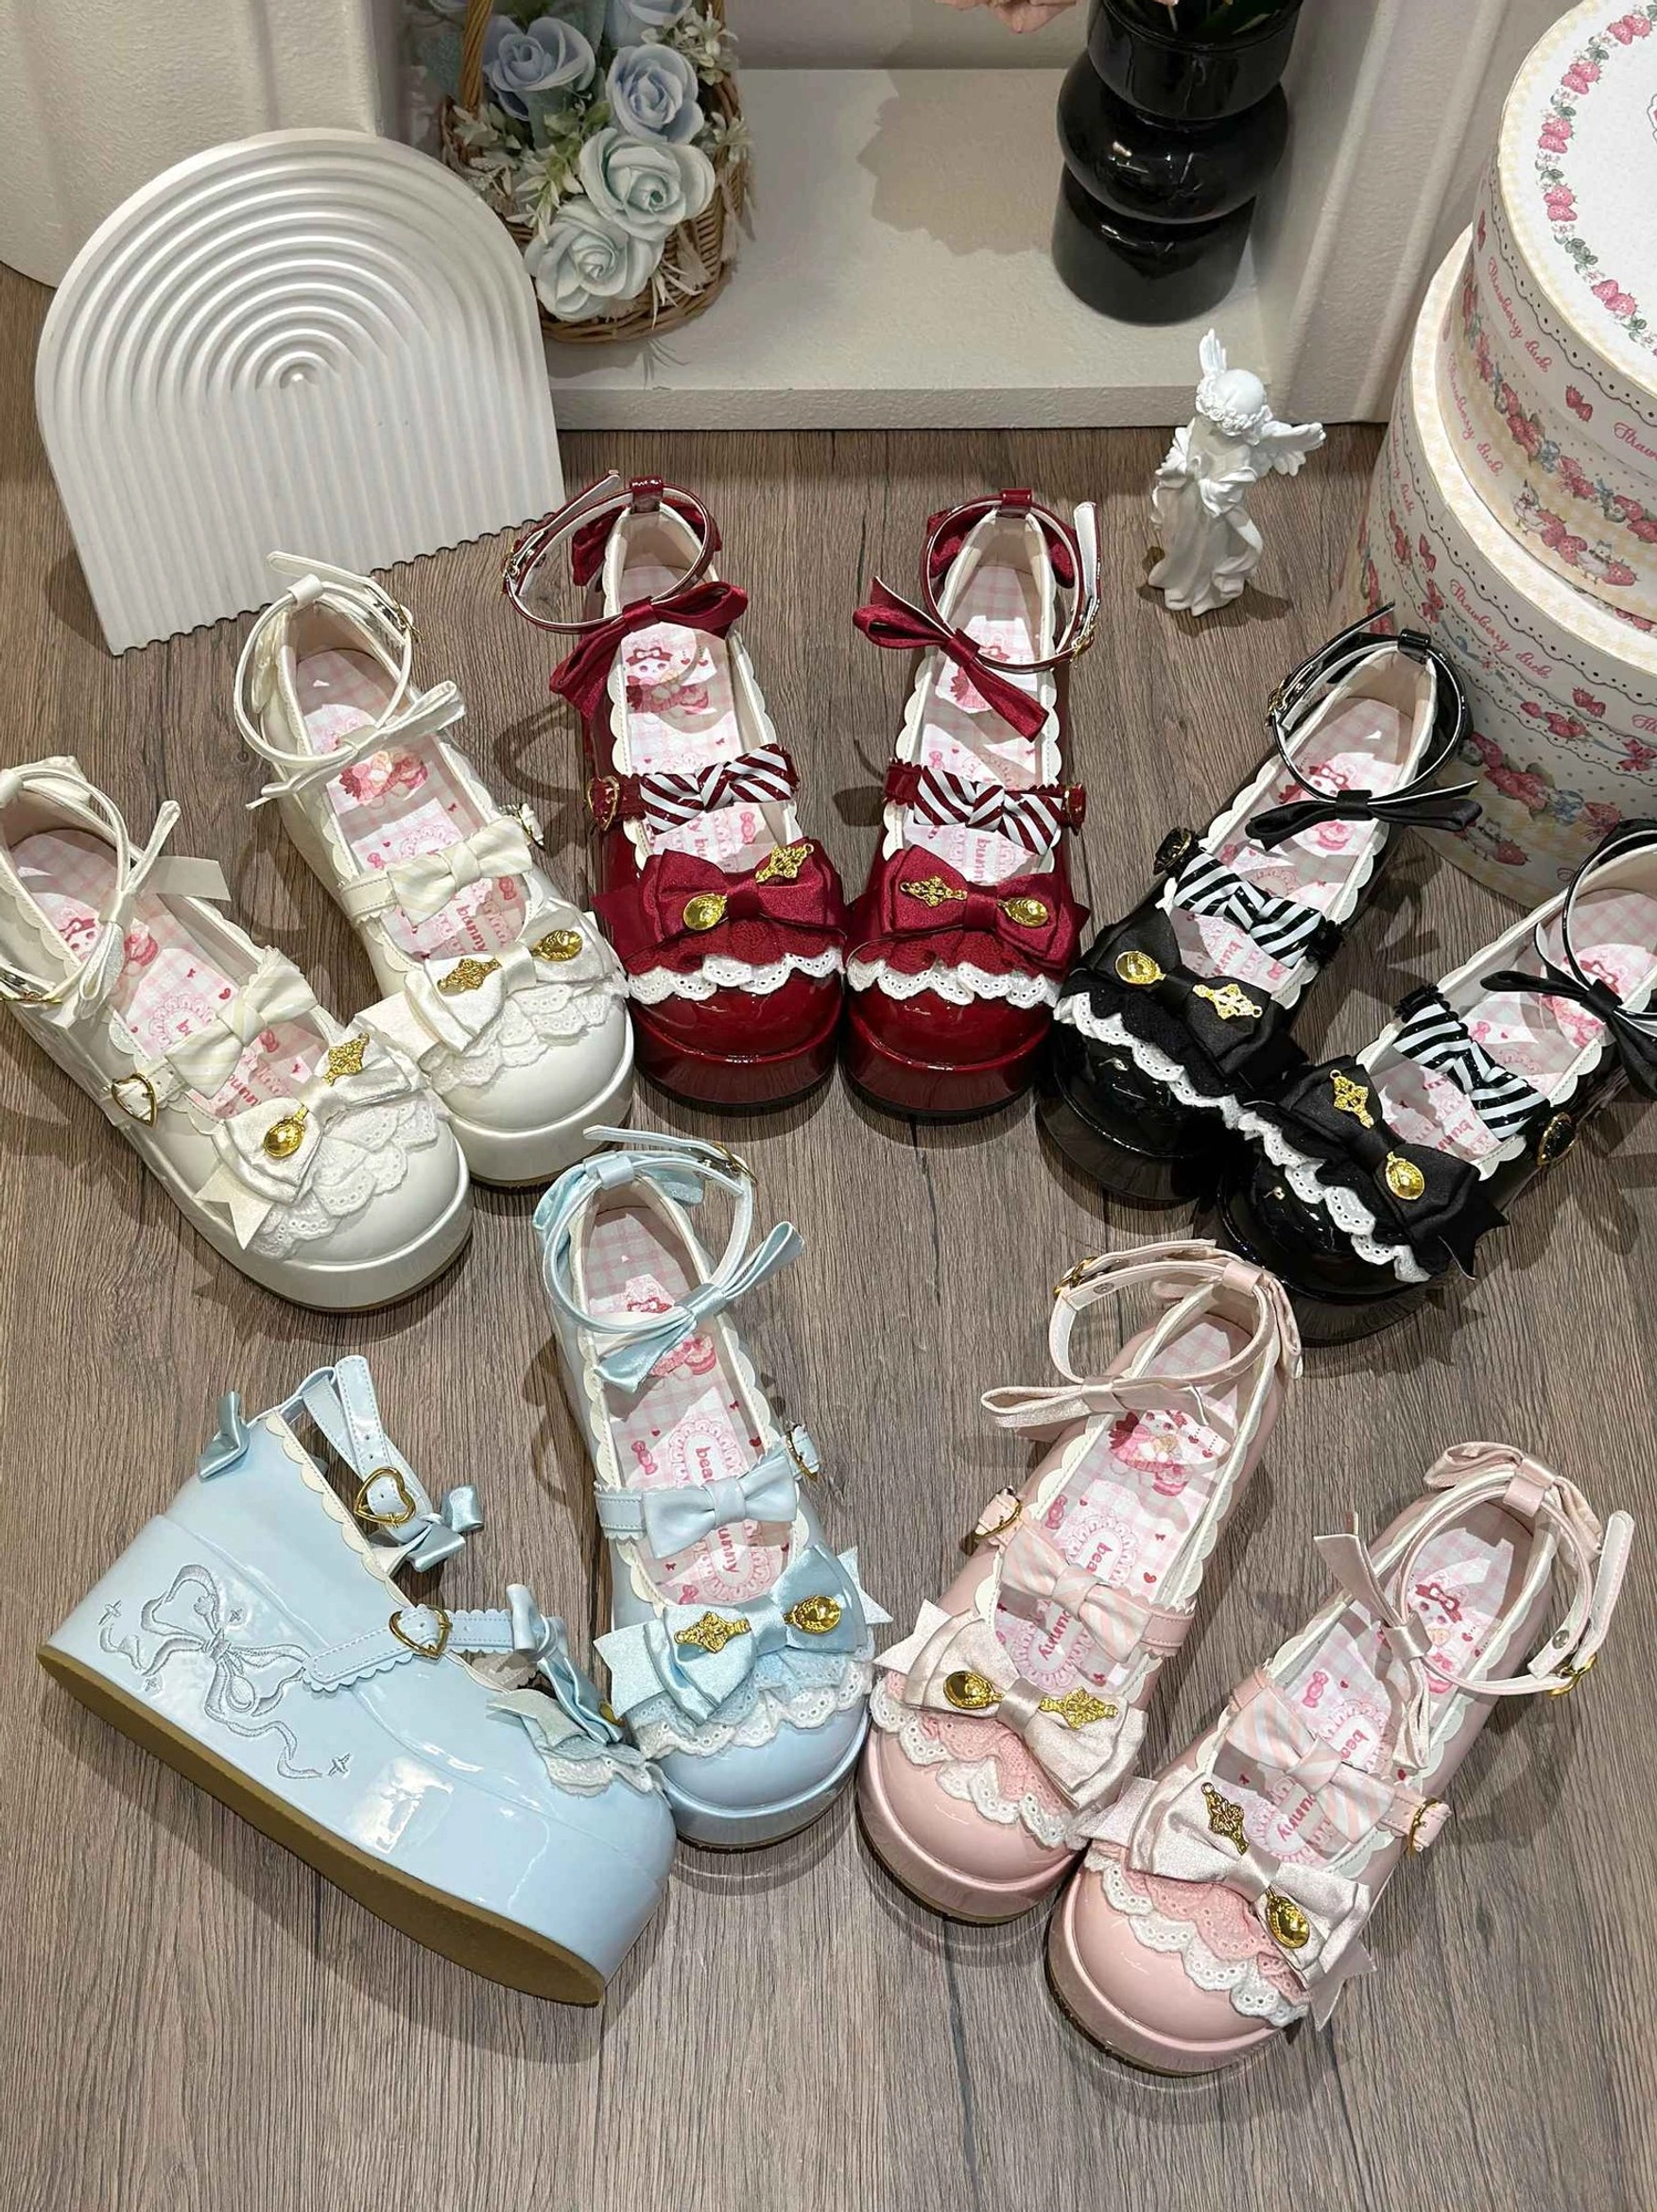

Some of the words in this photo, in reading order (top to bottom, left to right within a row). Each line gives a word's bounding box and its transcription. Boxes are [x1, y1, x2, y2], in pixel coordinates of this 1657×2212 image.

[1488, 256, 1523, 339] Strawberry
[1450, 579, 1510, 652] Strawberry
[973, 838, 992, 884] bunn
[456, 905, 490, 951] bunny
[228, 1074, 261, 1107] unn
[695, 1446, 716, 1483] bea
[716, 1527, 740, 1573] unny
[1085, 1542, 1113, 1573] bea
